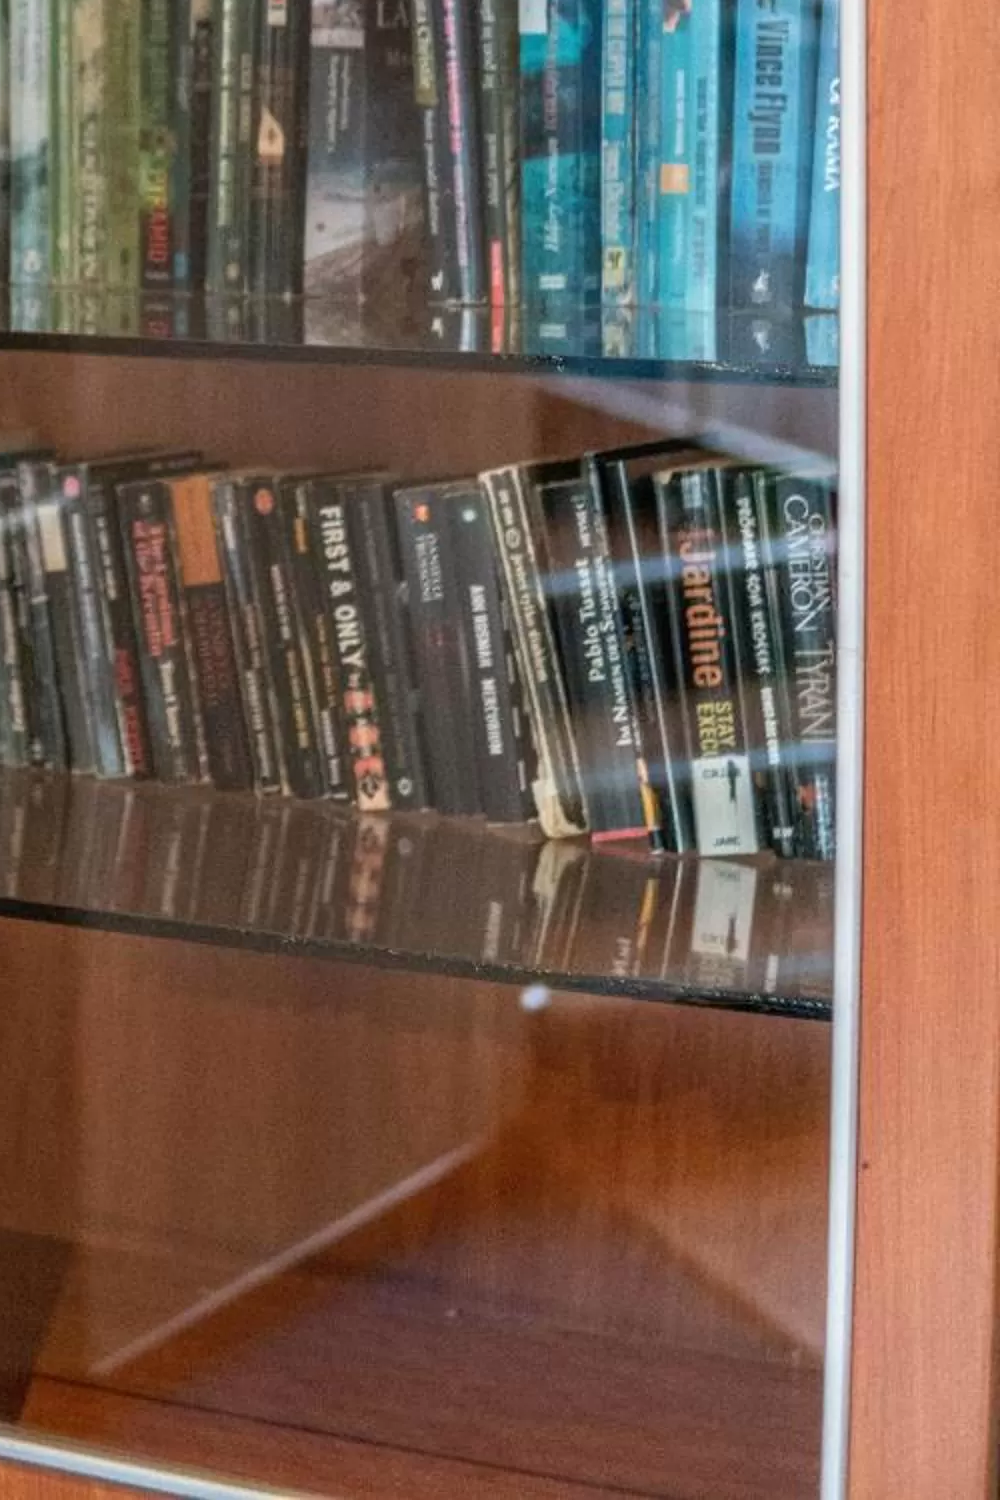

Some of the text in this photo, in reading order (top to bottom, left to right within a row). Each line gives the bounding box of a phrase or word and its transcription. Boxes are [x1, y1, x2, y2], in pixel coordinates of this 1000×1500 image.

[755, 19, 789, 85] Vince
[748, 92, 788, 153] Flynn
[319, 505, 350, 572] FIRST
[784, 495, 816, 632] CAMERON
[808, 513, 830, 607] CHRISTIAN
[331, 580, 352, 597] &
[679, 540, 726, 689] Jardine
[333, 604, 366, 667] ONLY
[583, 624, 606, 682] Pablo
[716, 701, 736, 748] STAY
